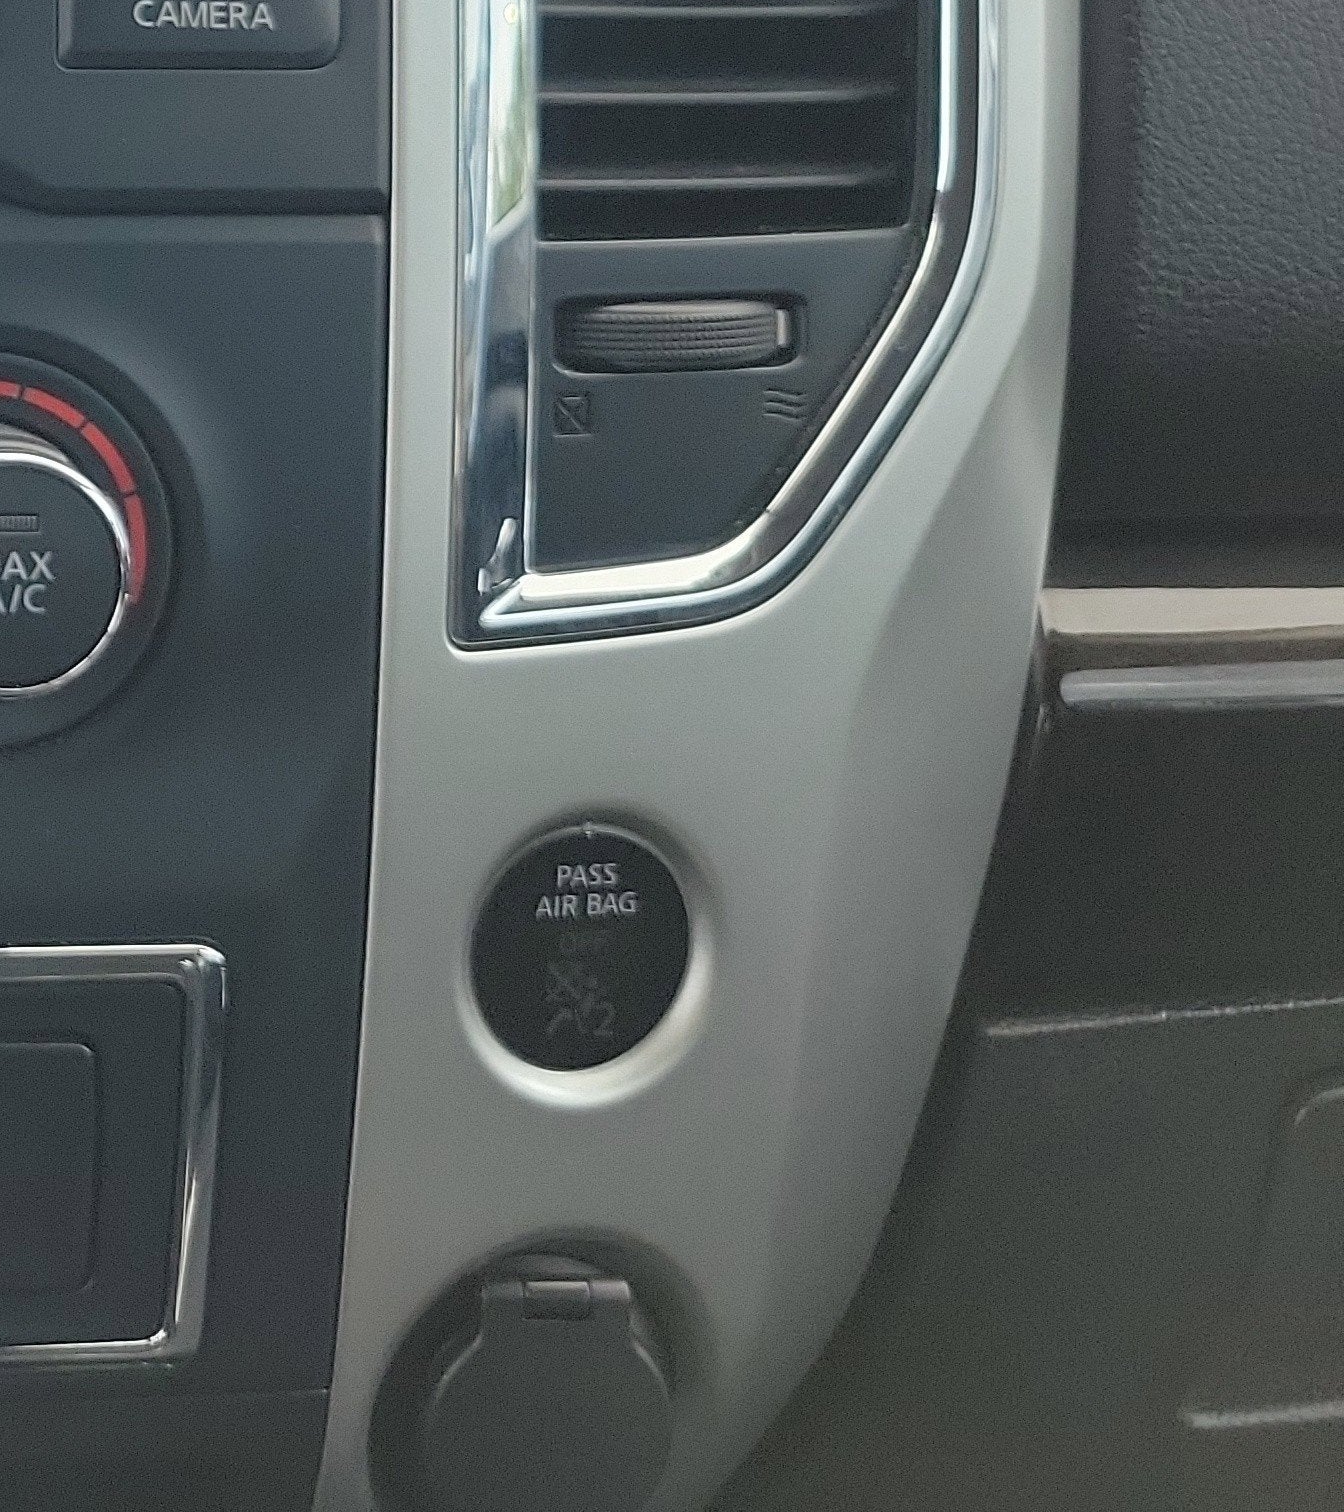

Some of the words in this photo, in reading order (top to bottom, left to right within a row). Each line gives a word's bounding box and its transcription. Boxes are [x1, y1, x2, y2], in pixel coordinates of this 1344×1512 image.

[133, 0, 275, 31] CAMERA
[556, 863, 618, 887] PASS
[535, 895, 578, 920] AIR
[586, 891, 639, 916] BAG
